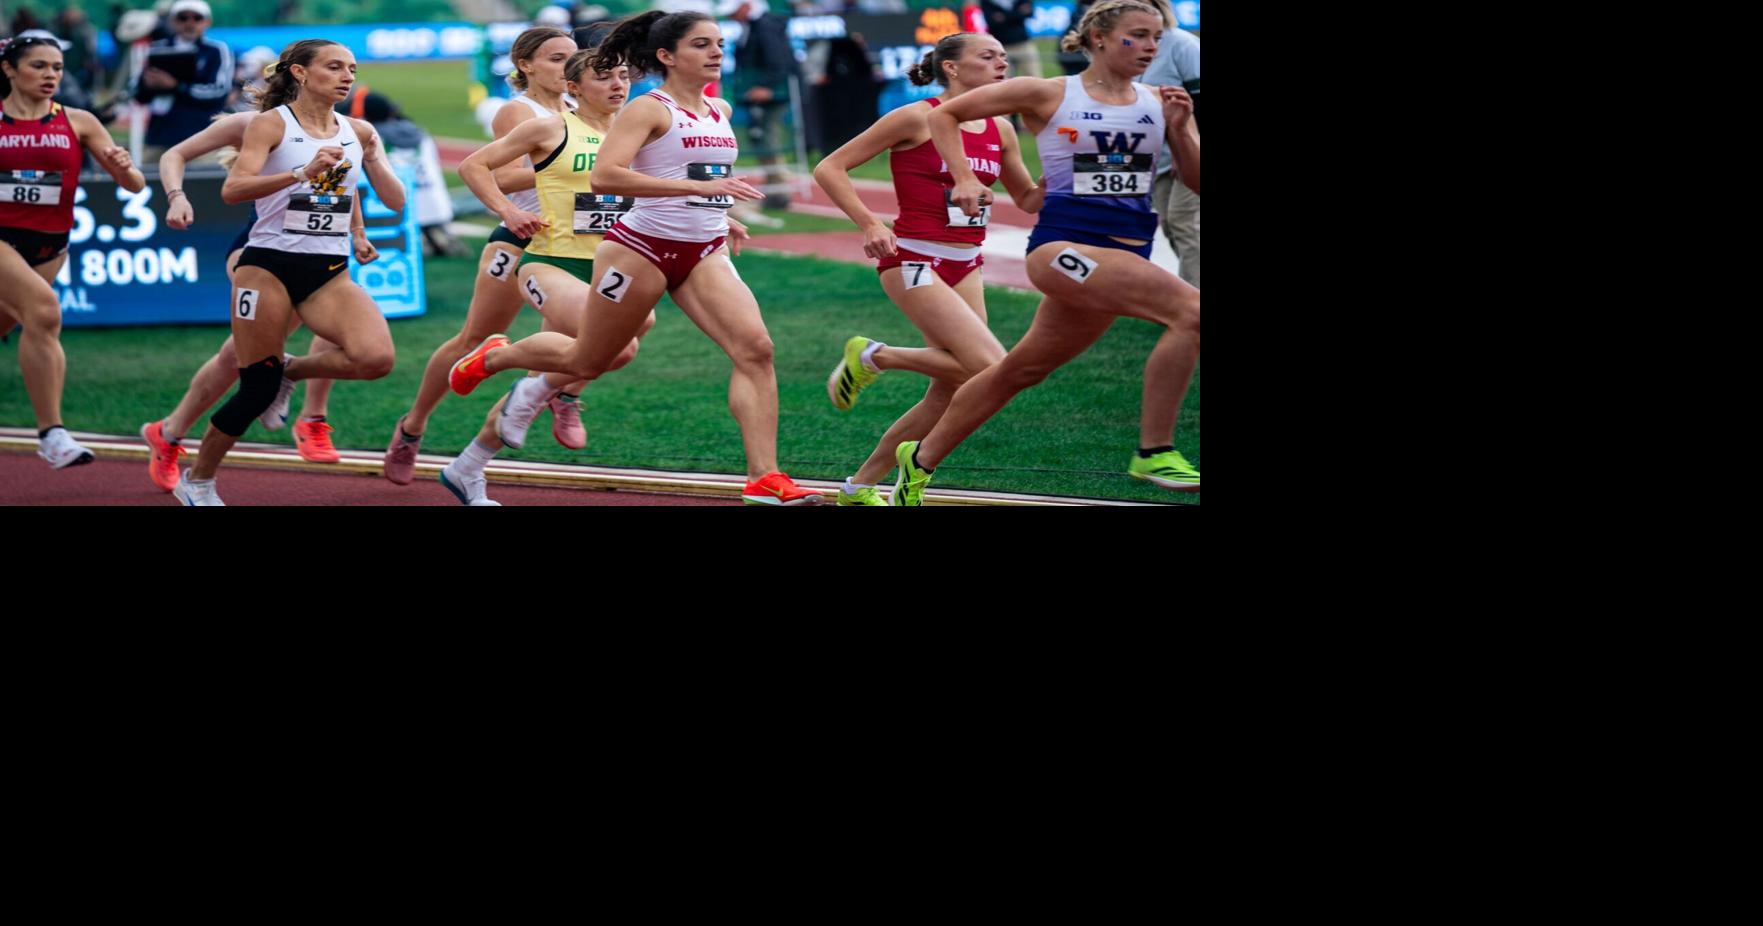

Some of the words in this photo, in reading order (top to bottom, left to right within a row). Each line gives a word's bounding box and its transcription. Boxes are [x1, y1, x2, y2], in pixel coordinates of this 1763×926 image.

[1089, 130, 1146, 153] W
[12, 186, 41, 203] 86
[1092, 174, 1138, 193] 384
[307, 213, 333, 231] 52
[80, 246, 199, 286] 800M
[490, 251, 510, 277] 3
[907, 262, 926, 287] 7
[1057, 252, 1091, 278] 9
[525, 279, 544, 306] 5
[600, 270, 625, 300] 2
[239, 290, 252, 317] 6
